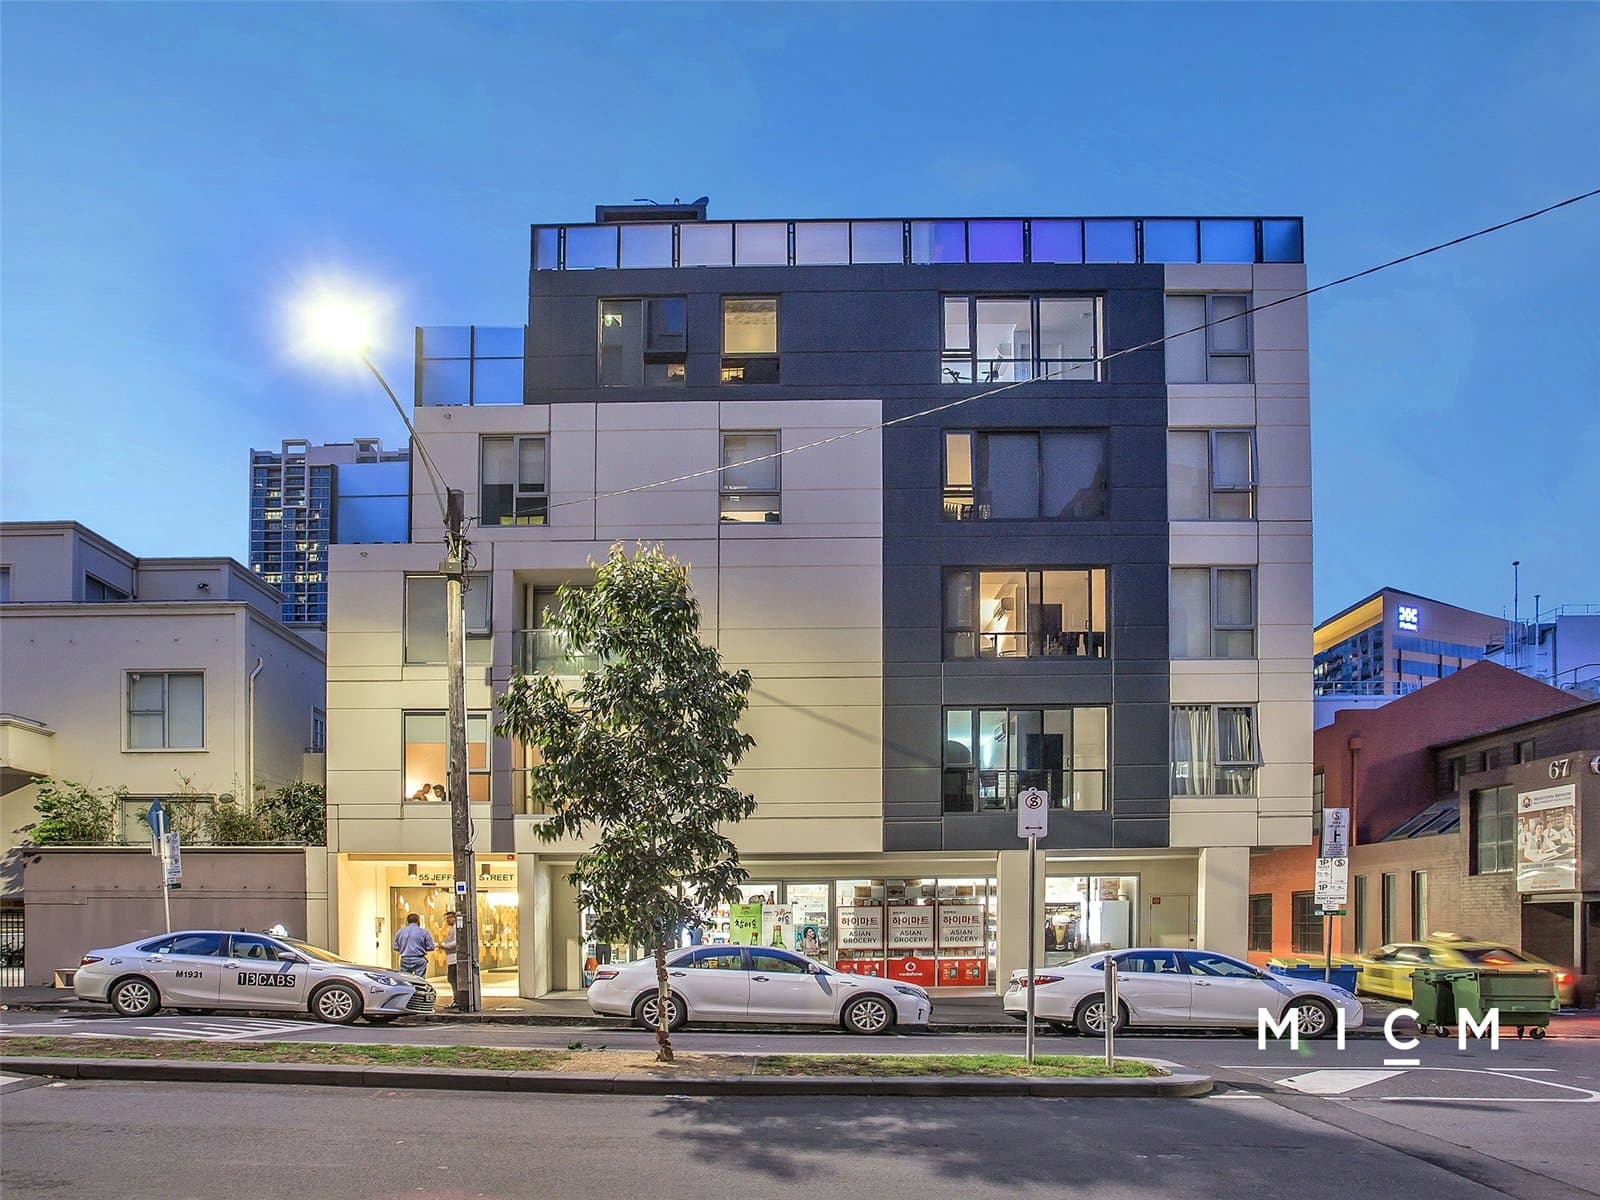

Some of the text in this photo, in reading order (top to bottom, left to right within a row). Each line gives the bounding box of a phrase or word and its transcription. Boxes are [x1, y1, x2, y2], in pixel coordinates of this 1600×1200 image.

[1548, 759, 1570, 779] 67
[419, 873, 430, 881] 55
[841, 916, 878, 926] 하이마트
[892, 916, 929, 926] 하이마트
[943, 915, 980, 925] 하이마트
[175, 970, 203, 979] M1931
[238, 972, 296, 987] 13CABS
